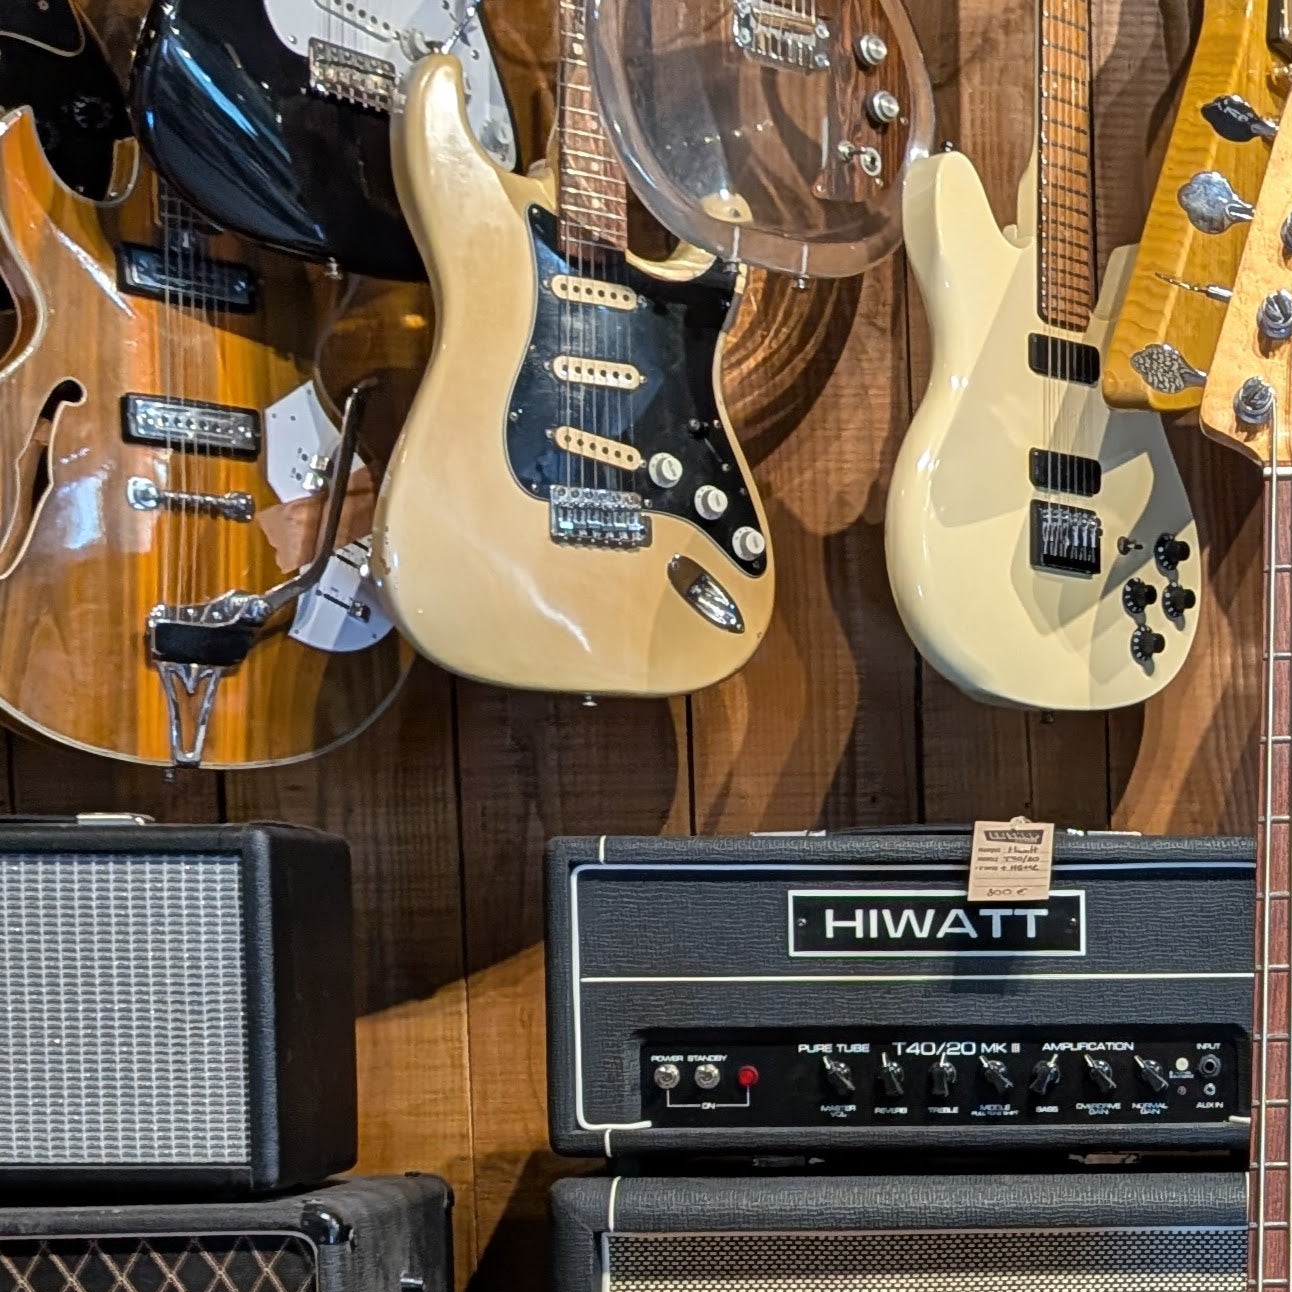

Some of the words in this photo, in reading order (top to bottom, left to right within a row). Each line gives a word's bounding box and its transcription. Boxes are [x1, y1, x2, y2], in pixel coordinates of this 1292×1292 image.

[824, 908, 1049, 939] HIWATT
[798, 1043, 833, 1053] PURE
[836, 1043, 871, 1053] TUBE
[892, 1041, 977, 1056] T40/20
[980, 1042, 1008, 1053] MK
[1041, 1041, 1135, 1051] AMPLIFICATION
[1196, 1042, 1222, 1050] INPUT
[650, 1054, 684, 1062] POWER
[687, 1054, 728, 1062] STANDBY
[701, 1102, 717, 1110] ON
[1035, 1105, 1059, 1113] BASS
